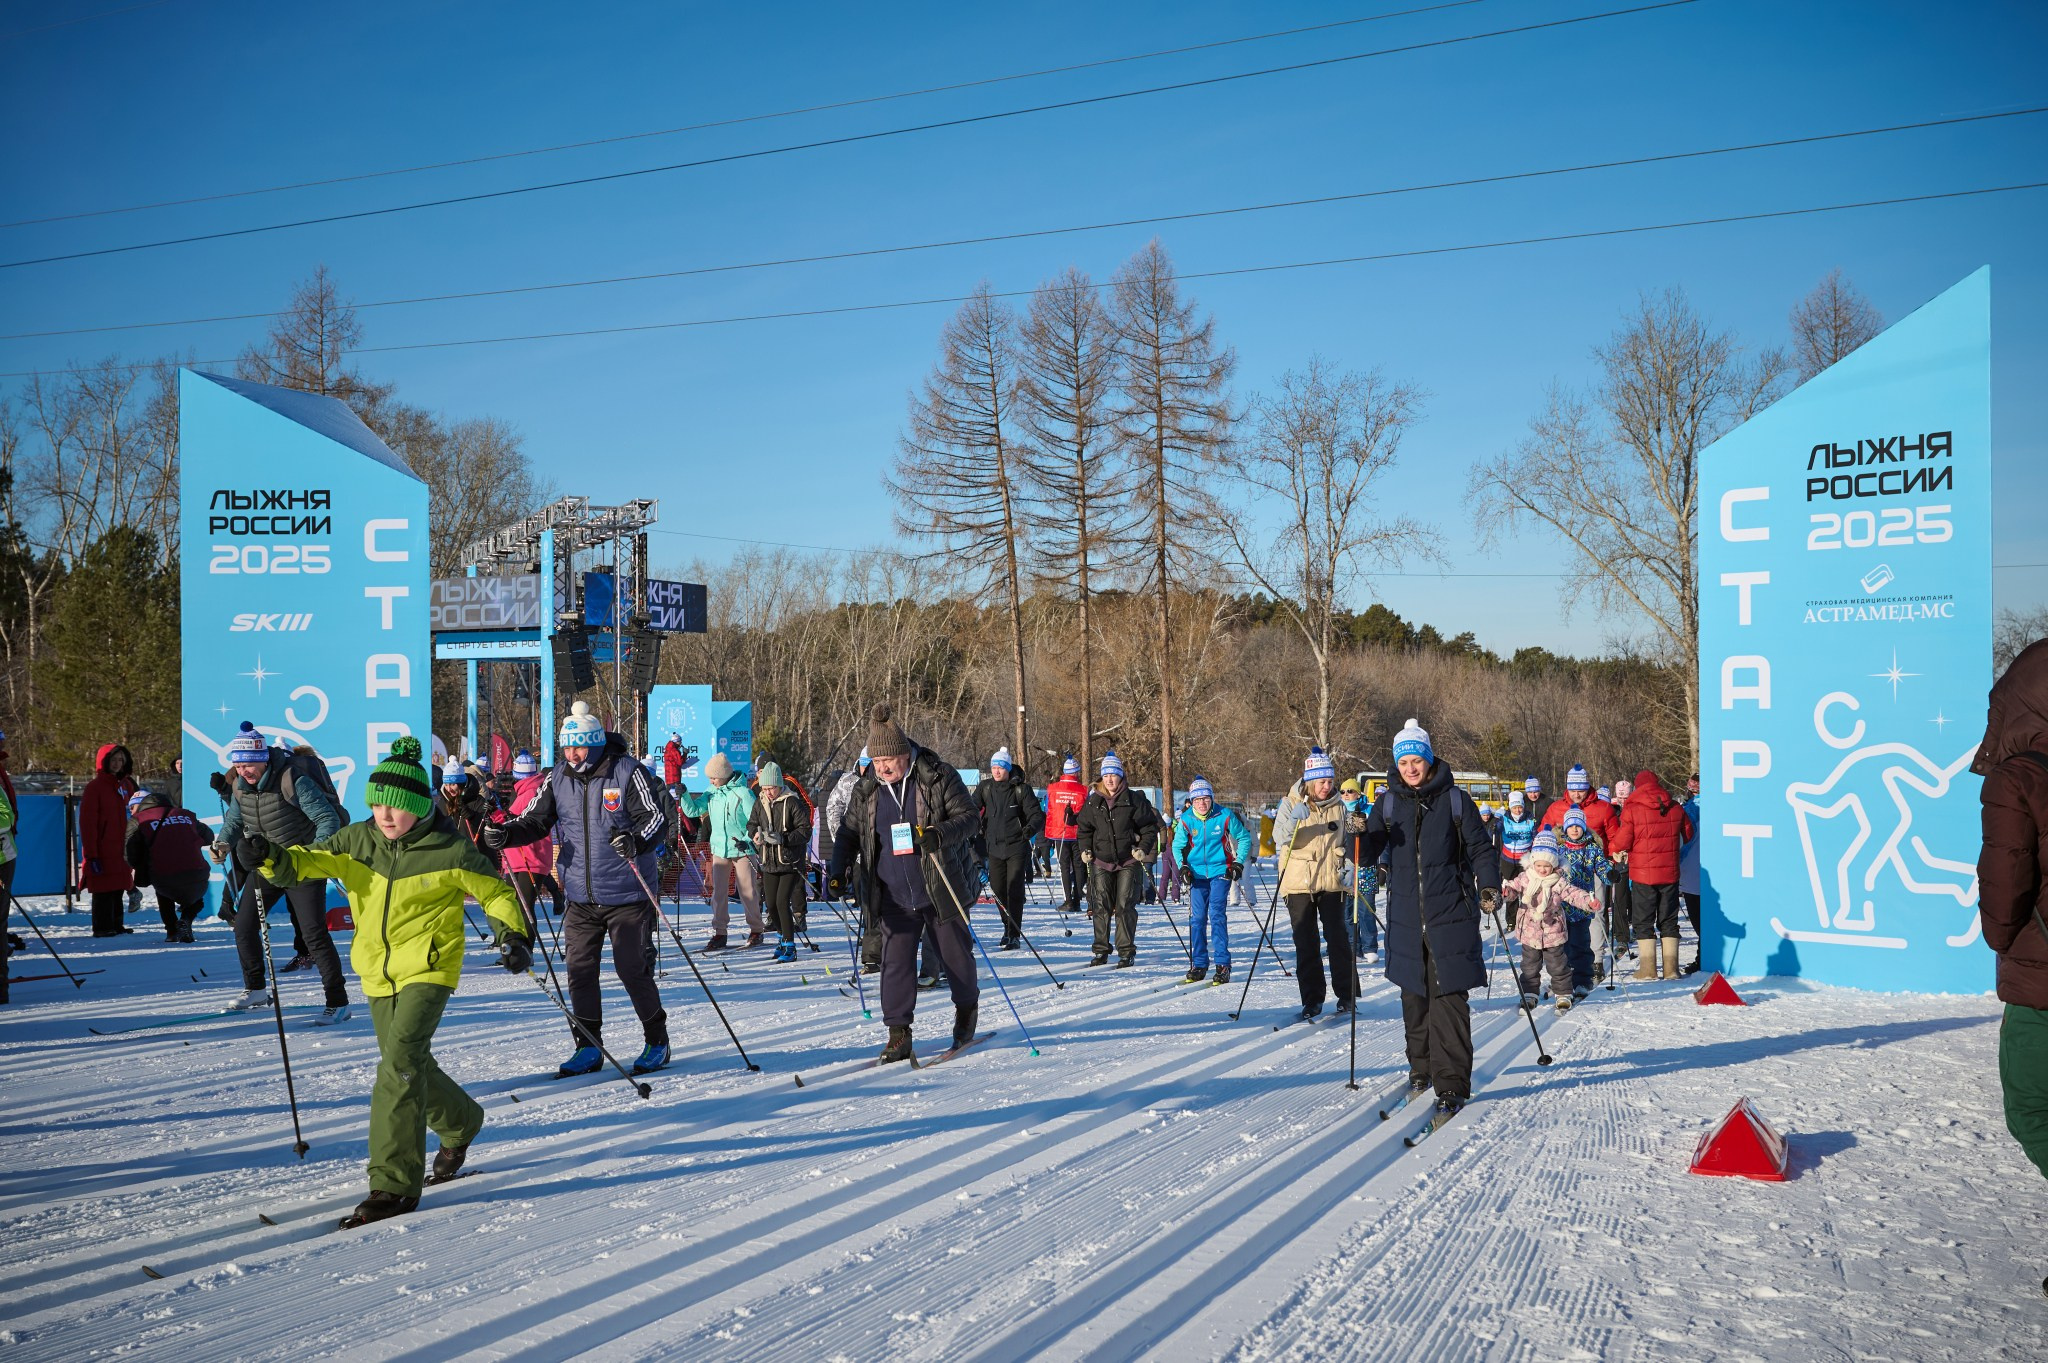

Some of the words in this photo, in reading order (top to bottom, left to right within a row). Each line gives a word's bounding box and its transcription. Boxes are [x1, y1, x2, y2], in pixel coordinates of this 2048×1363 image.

[1807, 431, 1953, 470] ЛЫЖНЯ
[1807, 466, 1953, 502] РОССИИ
[209, 490, 331, 510] ЛЫЖНЯ
[209, 516, 331, 535] РОССИИ
[1807, 504, 1954, 550] 2025
[209, 545, 331, 574] 2025
[430, 576, 536, 602] ЛЫЖНЯ
[1803, 602, 1955, 623] АСТРАМЕД-МС
[364, 519, 411, 766] СТАР
[446, 641, 493, 650] СТАРТУЕТ
[498, 640, 518, 649] ВСЯ
[521, 639, 541, 648] РОС
[1720, 486, 1773, 878] СТАРТ
[263, 930, 272, 959] WAY
